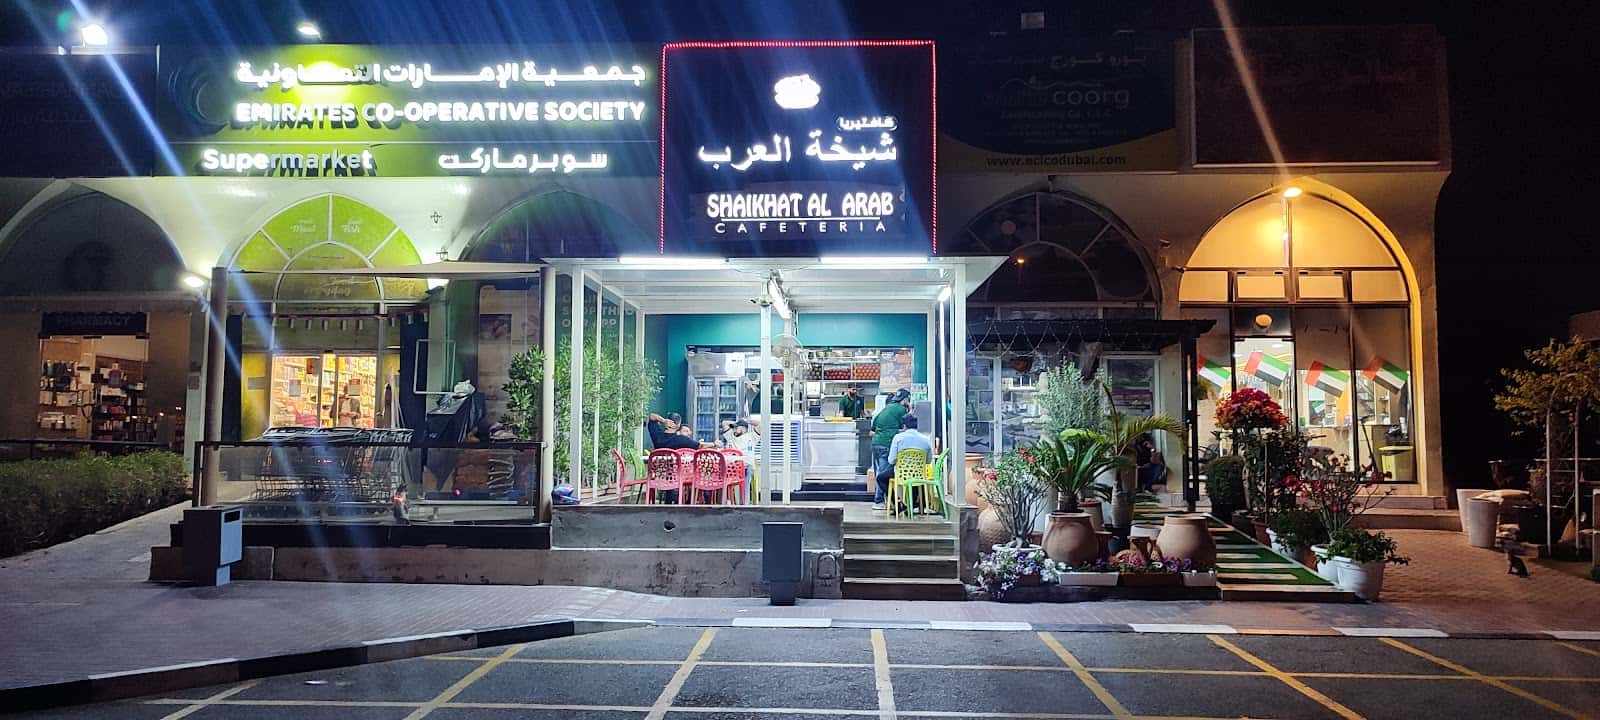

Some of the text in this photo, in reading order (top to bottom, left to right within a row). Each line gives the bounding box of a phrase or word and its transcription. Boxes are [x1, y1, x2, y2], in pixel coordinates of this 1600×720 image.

[384, 63, 519, 88] الإمارات
[522, 61, 646, 87] جمعية
[1053, 89, 1130, 110] coorg
[236, 101, 646, 122] EMIRATES CO-OPERATIVE SOCIETY
[203, 149, 373, 172] Supermarket
[699, 130, 897, 171] شيخة العرب
[707, 192, 894, 218] SHAIKHAT AL ARAB
[715, 221, 886, 233] CAFETERIA
[562, 306, 597, 316] SOP
